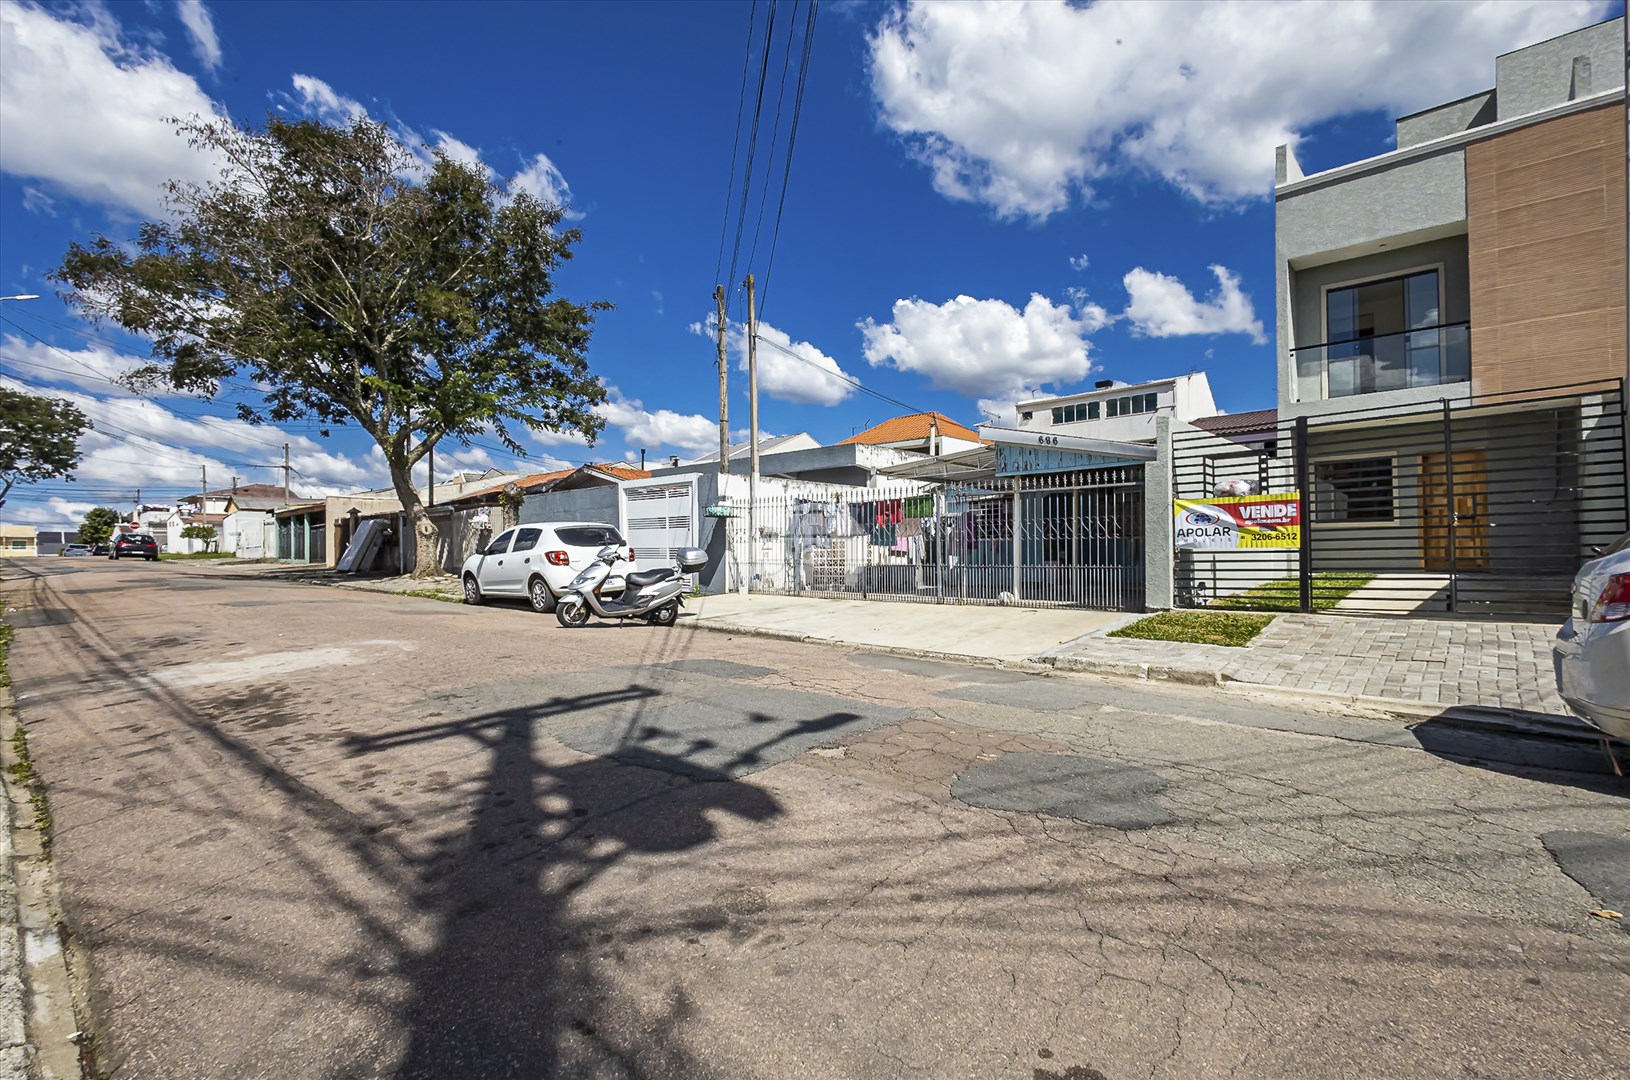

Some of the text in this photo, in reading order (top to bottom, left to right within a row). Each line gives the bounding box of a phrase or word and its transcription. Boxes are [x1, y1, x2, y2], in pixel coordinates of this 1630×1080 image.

[1238, 503, 1297, 519] VENDE
[1176, 526, 1231, 538] APOLAR
[1251, 532, 1298, 541] 3206-6512
